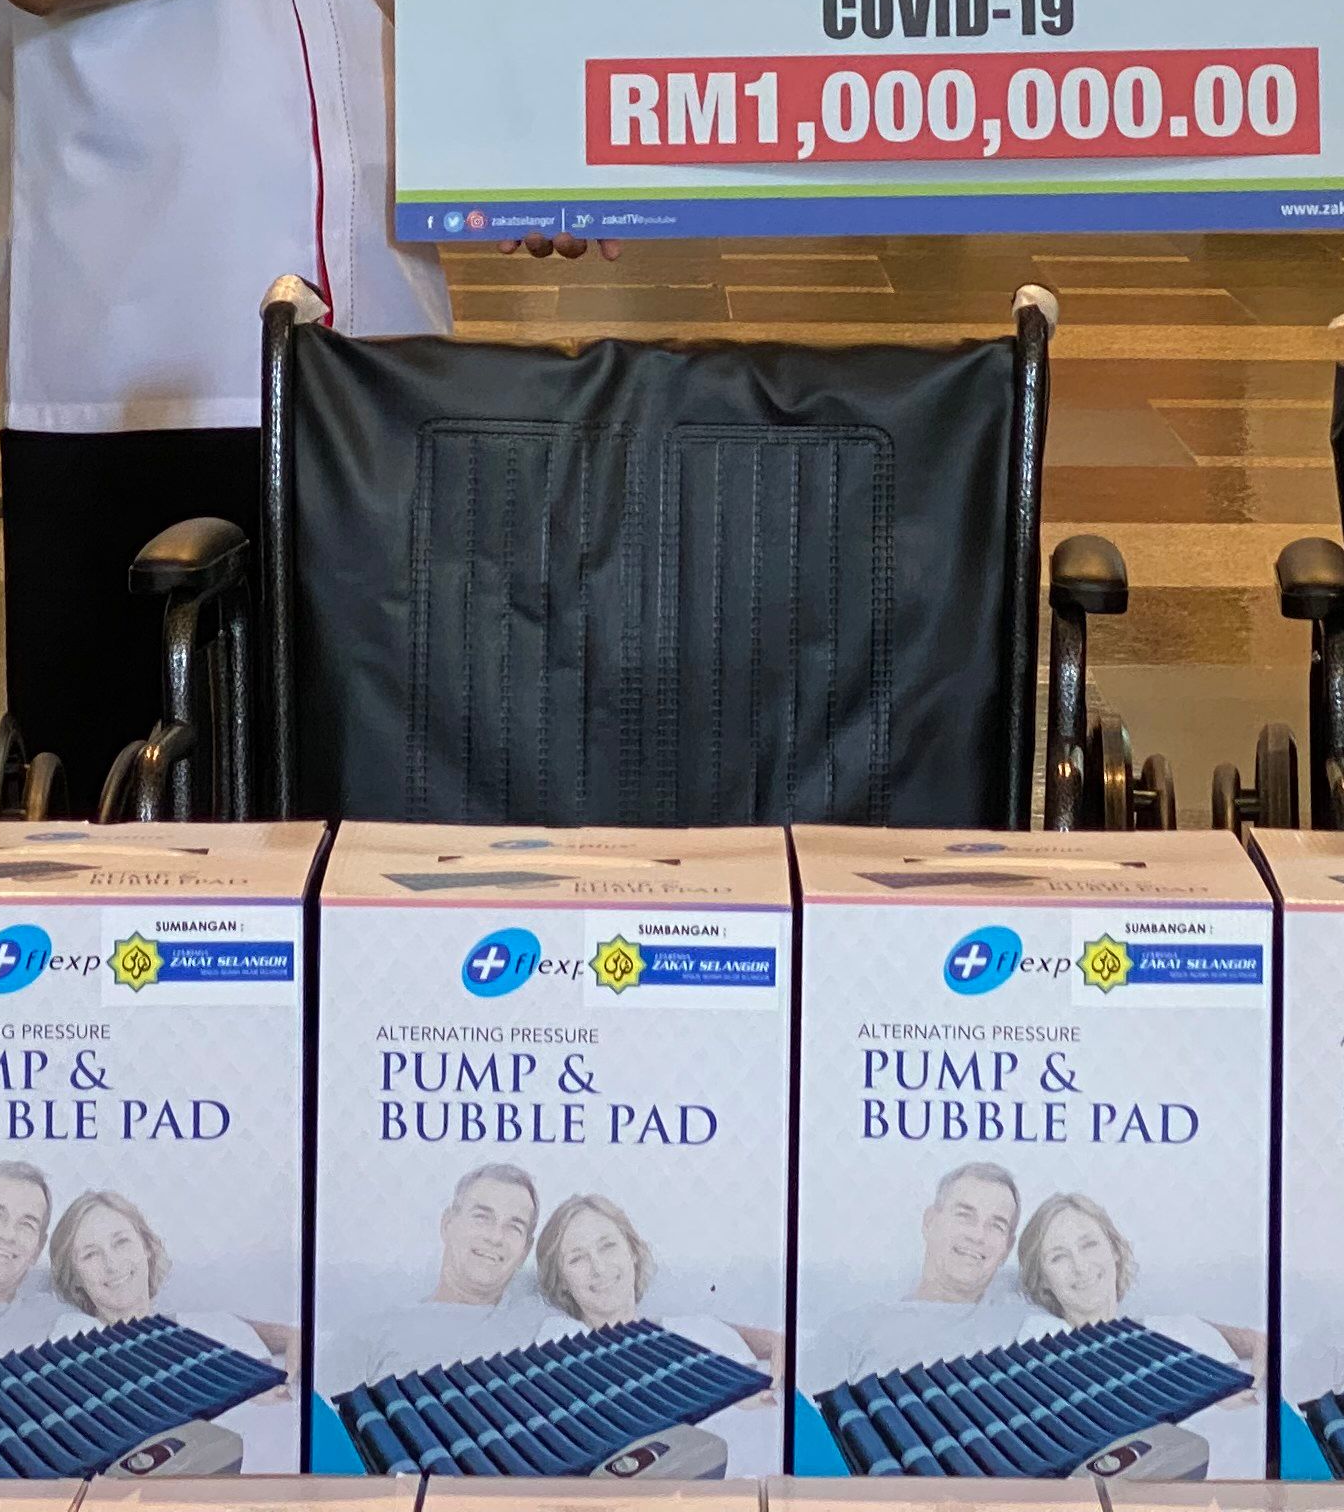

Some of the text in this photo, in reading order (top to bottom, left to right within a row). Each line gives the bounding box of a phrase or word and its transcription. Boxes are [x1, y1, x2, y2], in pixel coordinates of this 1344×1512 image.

[610, 64, 1297, 160] RM1,000,000.00
[1125, 923, 1206, 934] SUMBANGAN
[1139, 958, 1257, 970] ZAKAT SELANGOR
[858, 1023, 1082, 1042] ALTERNATING PRESSURE
[864, 1049, 1082, 1093] PUMP &
[863, 1099, 1199, 1144] BUBBLE PAD
